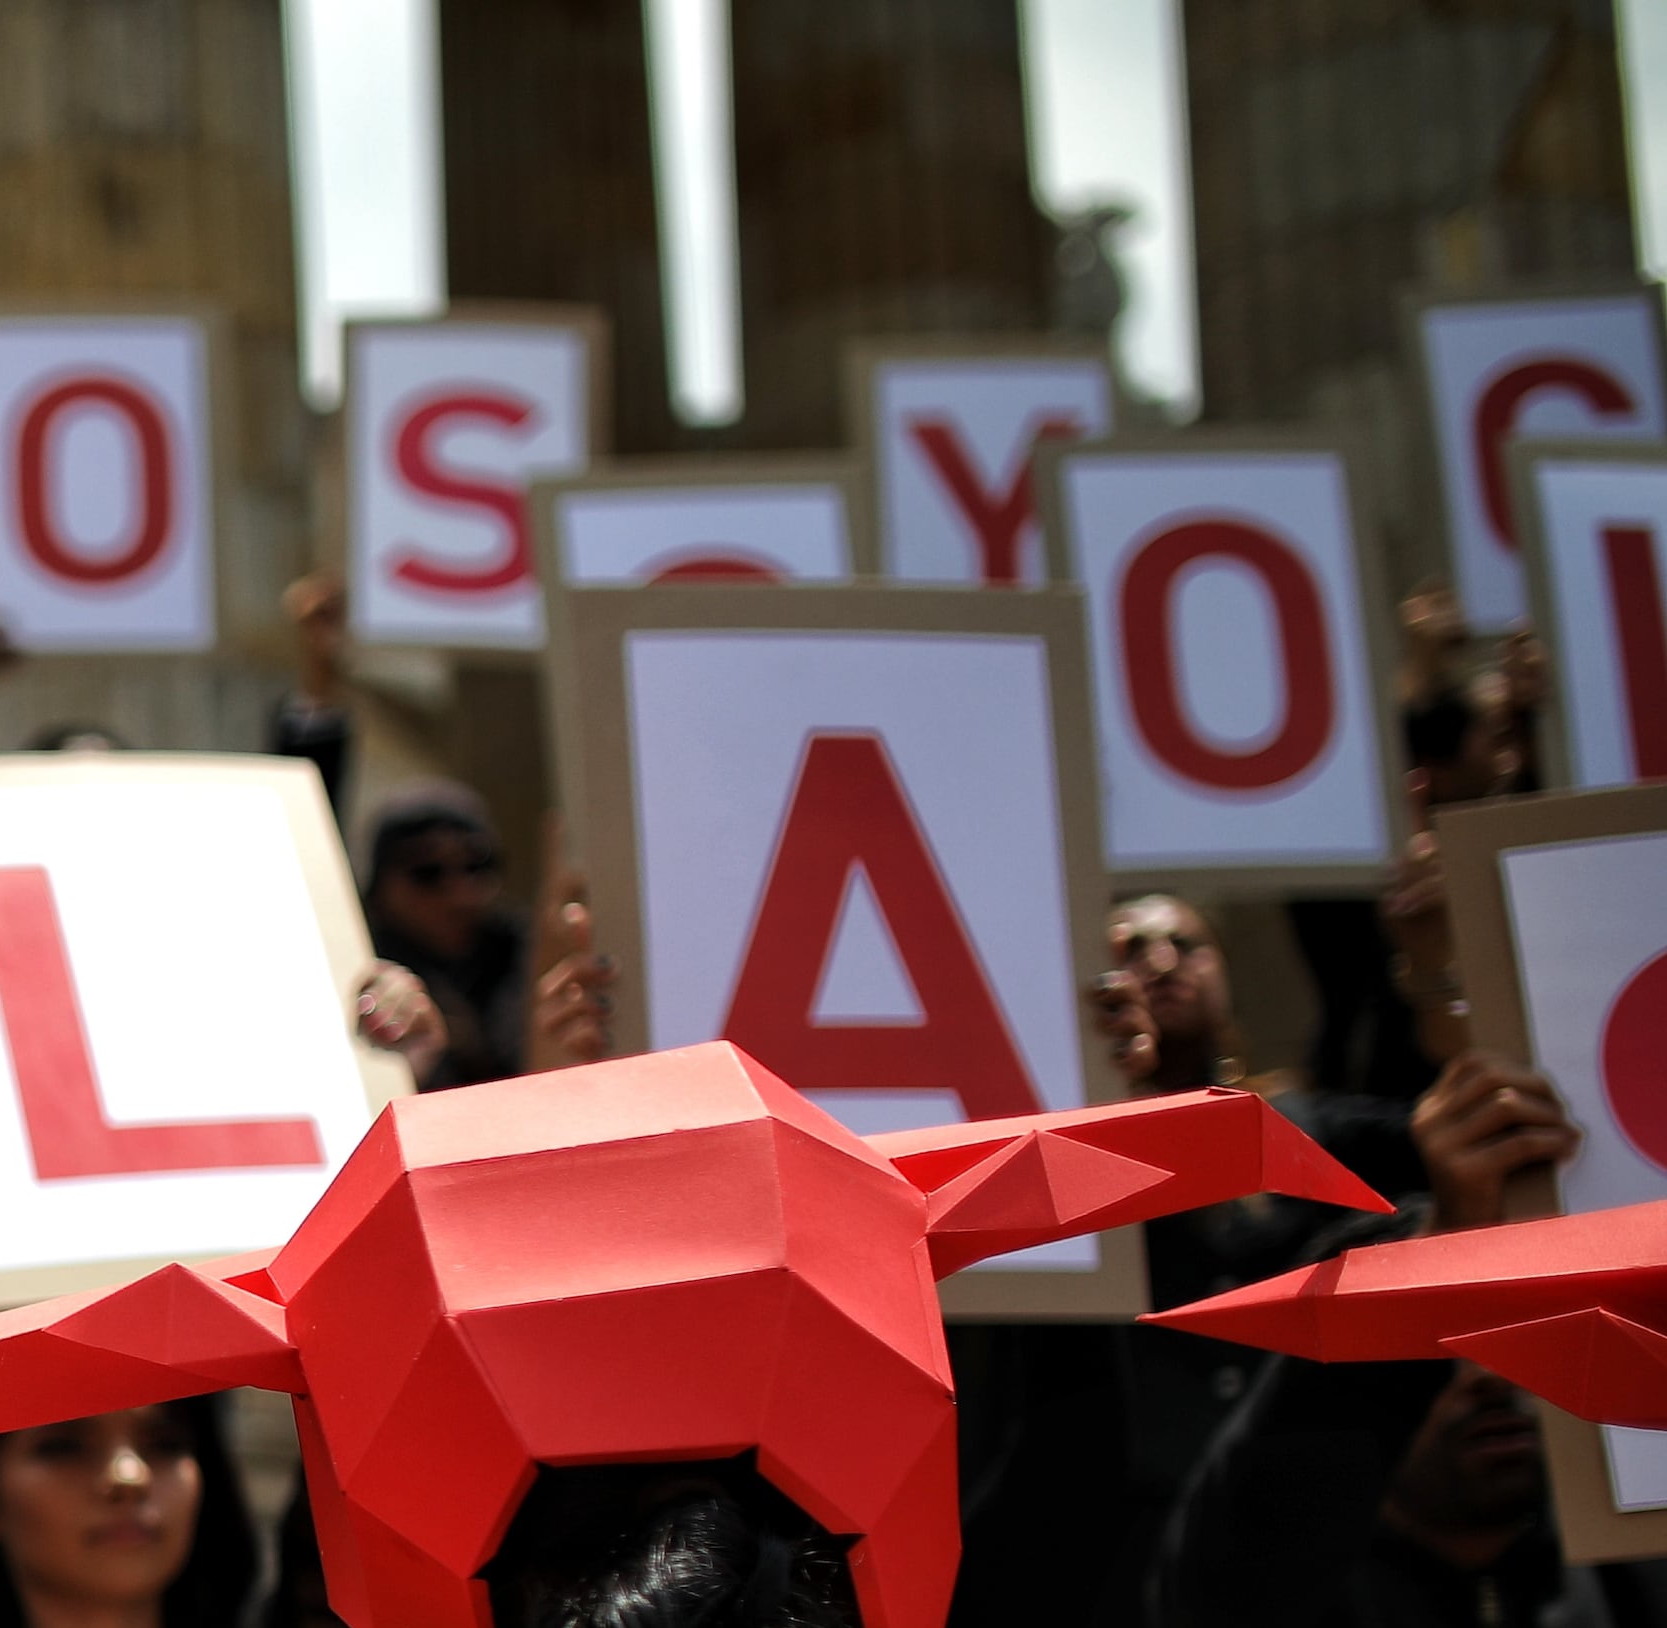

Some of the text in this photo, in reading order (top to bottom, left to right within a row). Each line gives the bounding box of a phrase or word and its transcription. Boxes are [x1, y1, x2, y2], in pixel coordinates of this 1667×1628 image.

[11, 371, 175, 586] O
[389, 386, 538, 597] S
[903, 412, 1083, 584] Y
[1117, 510, 1341, 794] O
[716, 726, 1045, 1116] A
